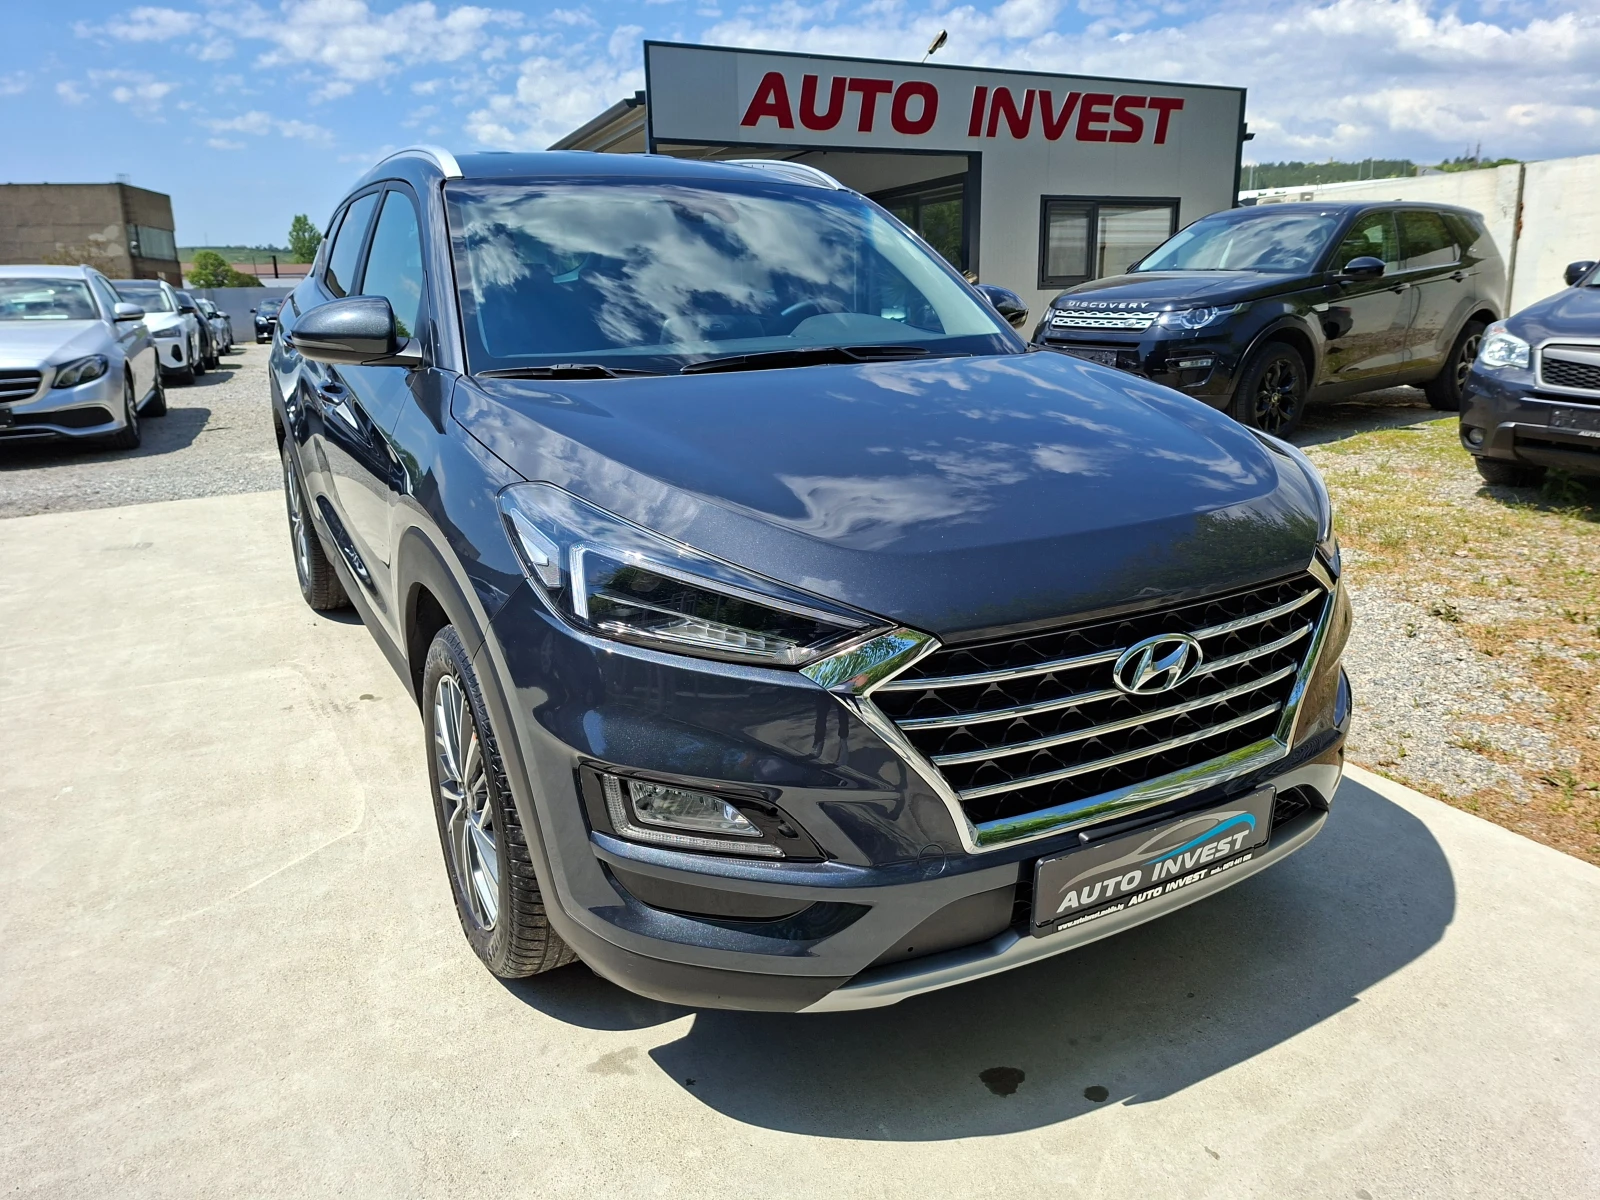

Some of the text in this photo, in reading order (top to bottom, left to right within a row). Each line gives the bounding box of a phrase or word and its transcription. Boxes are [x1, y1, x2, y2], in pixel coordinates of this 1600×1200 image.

[739, 71, 1185, 145] AUTO INVEST
[1068, 300, 1149, 309] DISCOVERY
[1056, 870, 1142, 914] AUTO
[1151, 829, 1251, 882] INVEST
[1127, 887, 1162, 907] AUTO
[1166, 869, 1209, 892] INVEST
